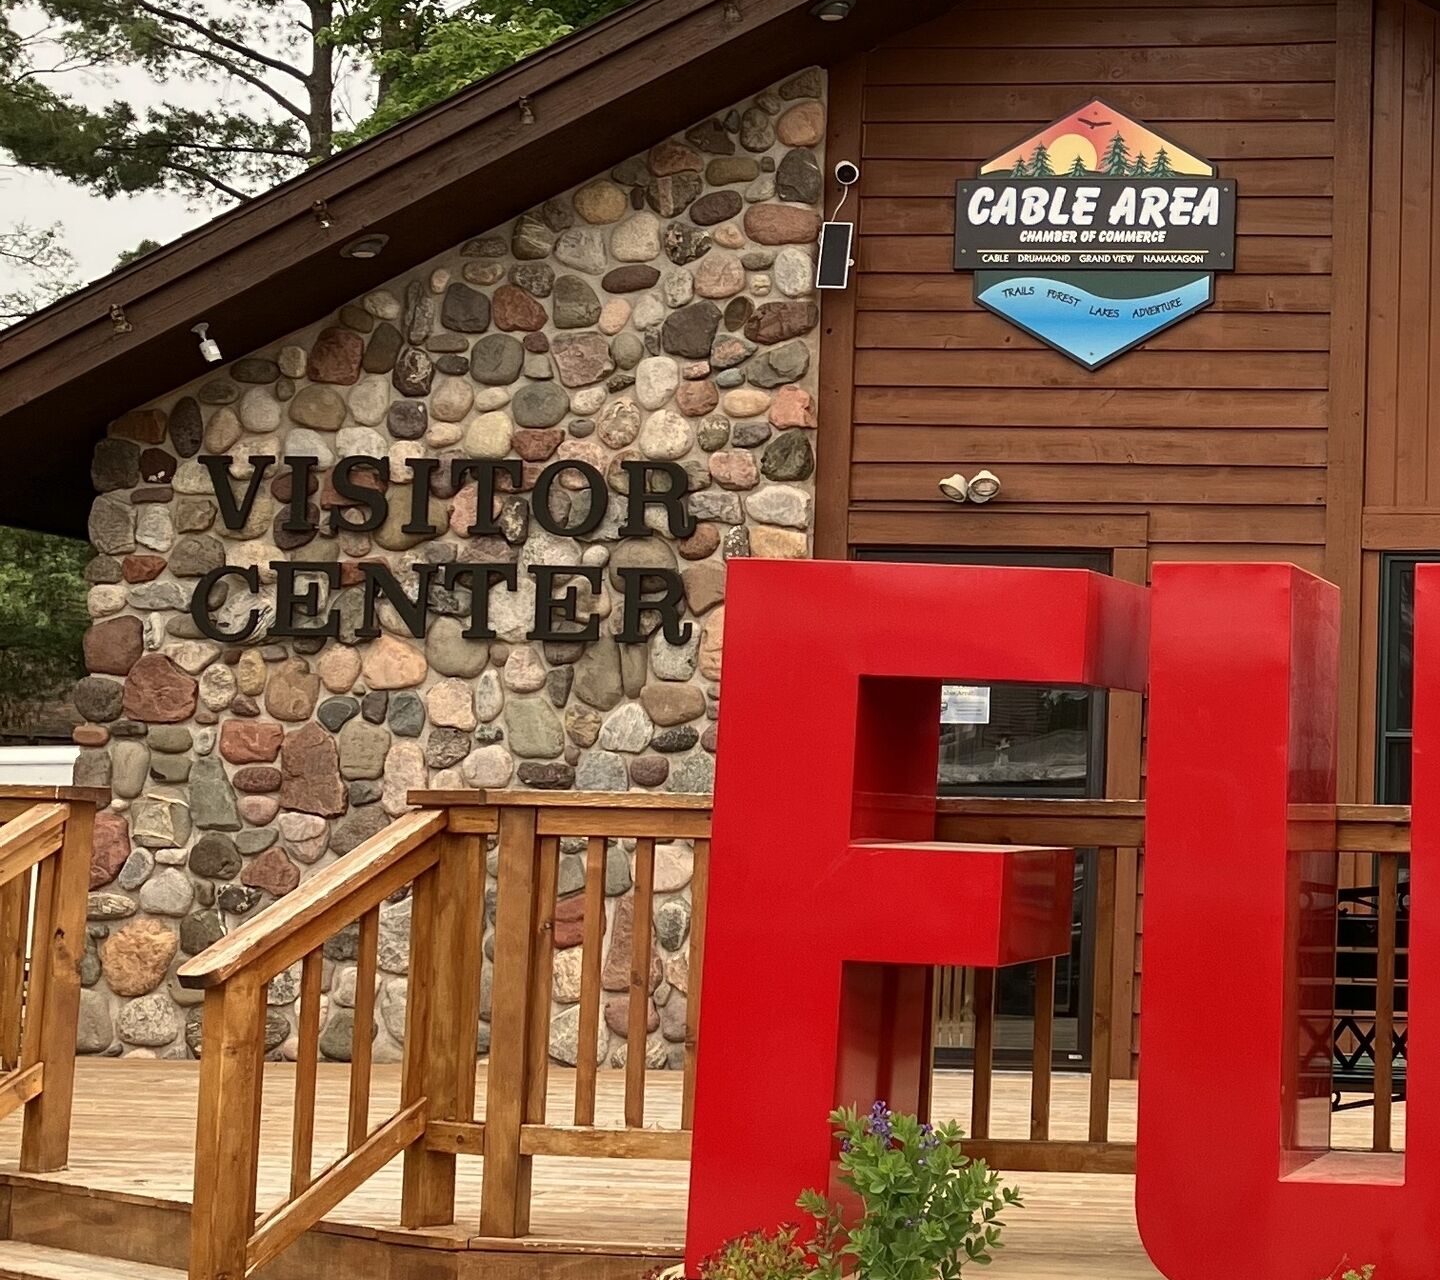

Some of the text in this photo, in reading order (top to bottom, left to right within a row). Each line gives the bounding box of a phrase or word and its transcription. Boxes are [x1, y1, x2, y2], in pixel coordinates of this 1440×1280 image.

[968, 186, 1219, 228] CABLE AREA
[1019, 230, 1166, 243] CHAMBER OF COMMERCE
[981, 253, 1204, 263] CABLE DRUMMOND GRAND VIEW NAMAKAGON
[1002, 286, 1183, 319] TRAILS FOREST LAKES ADVENTURE
[198, 454, 698, 538] VISITOR
[190, 560, 693, 646] CENTER
